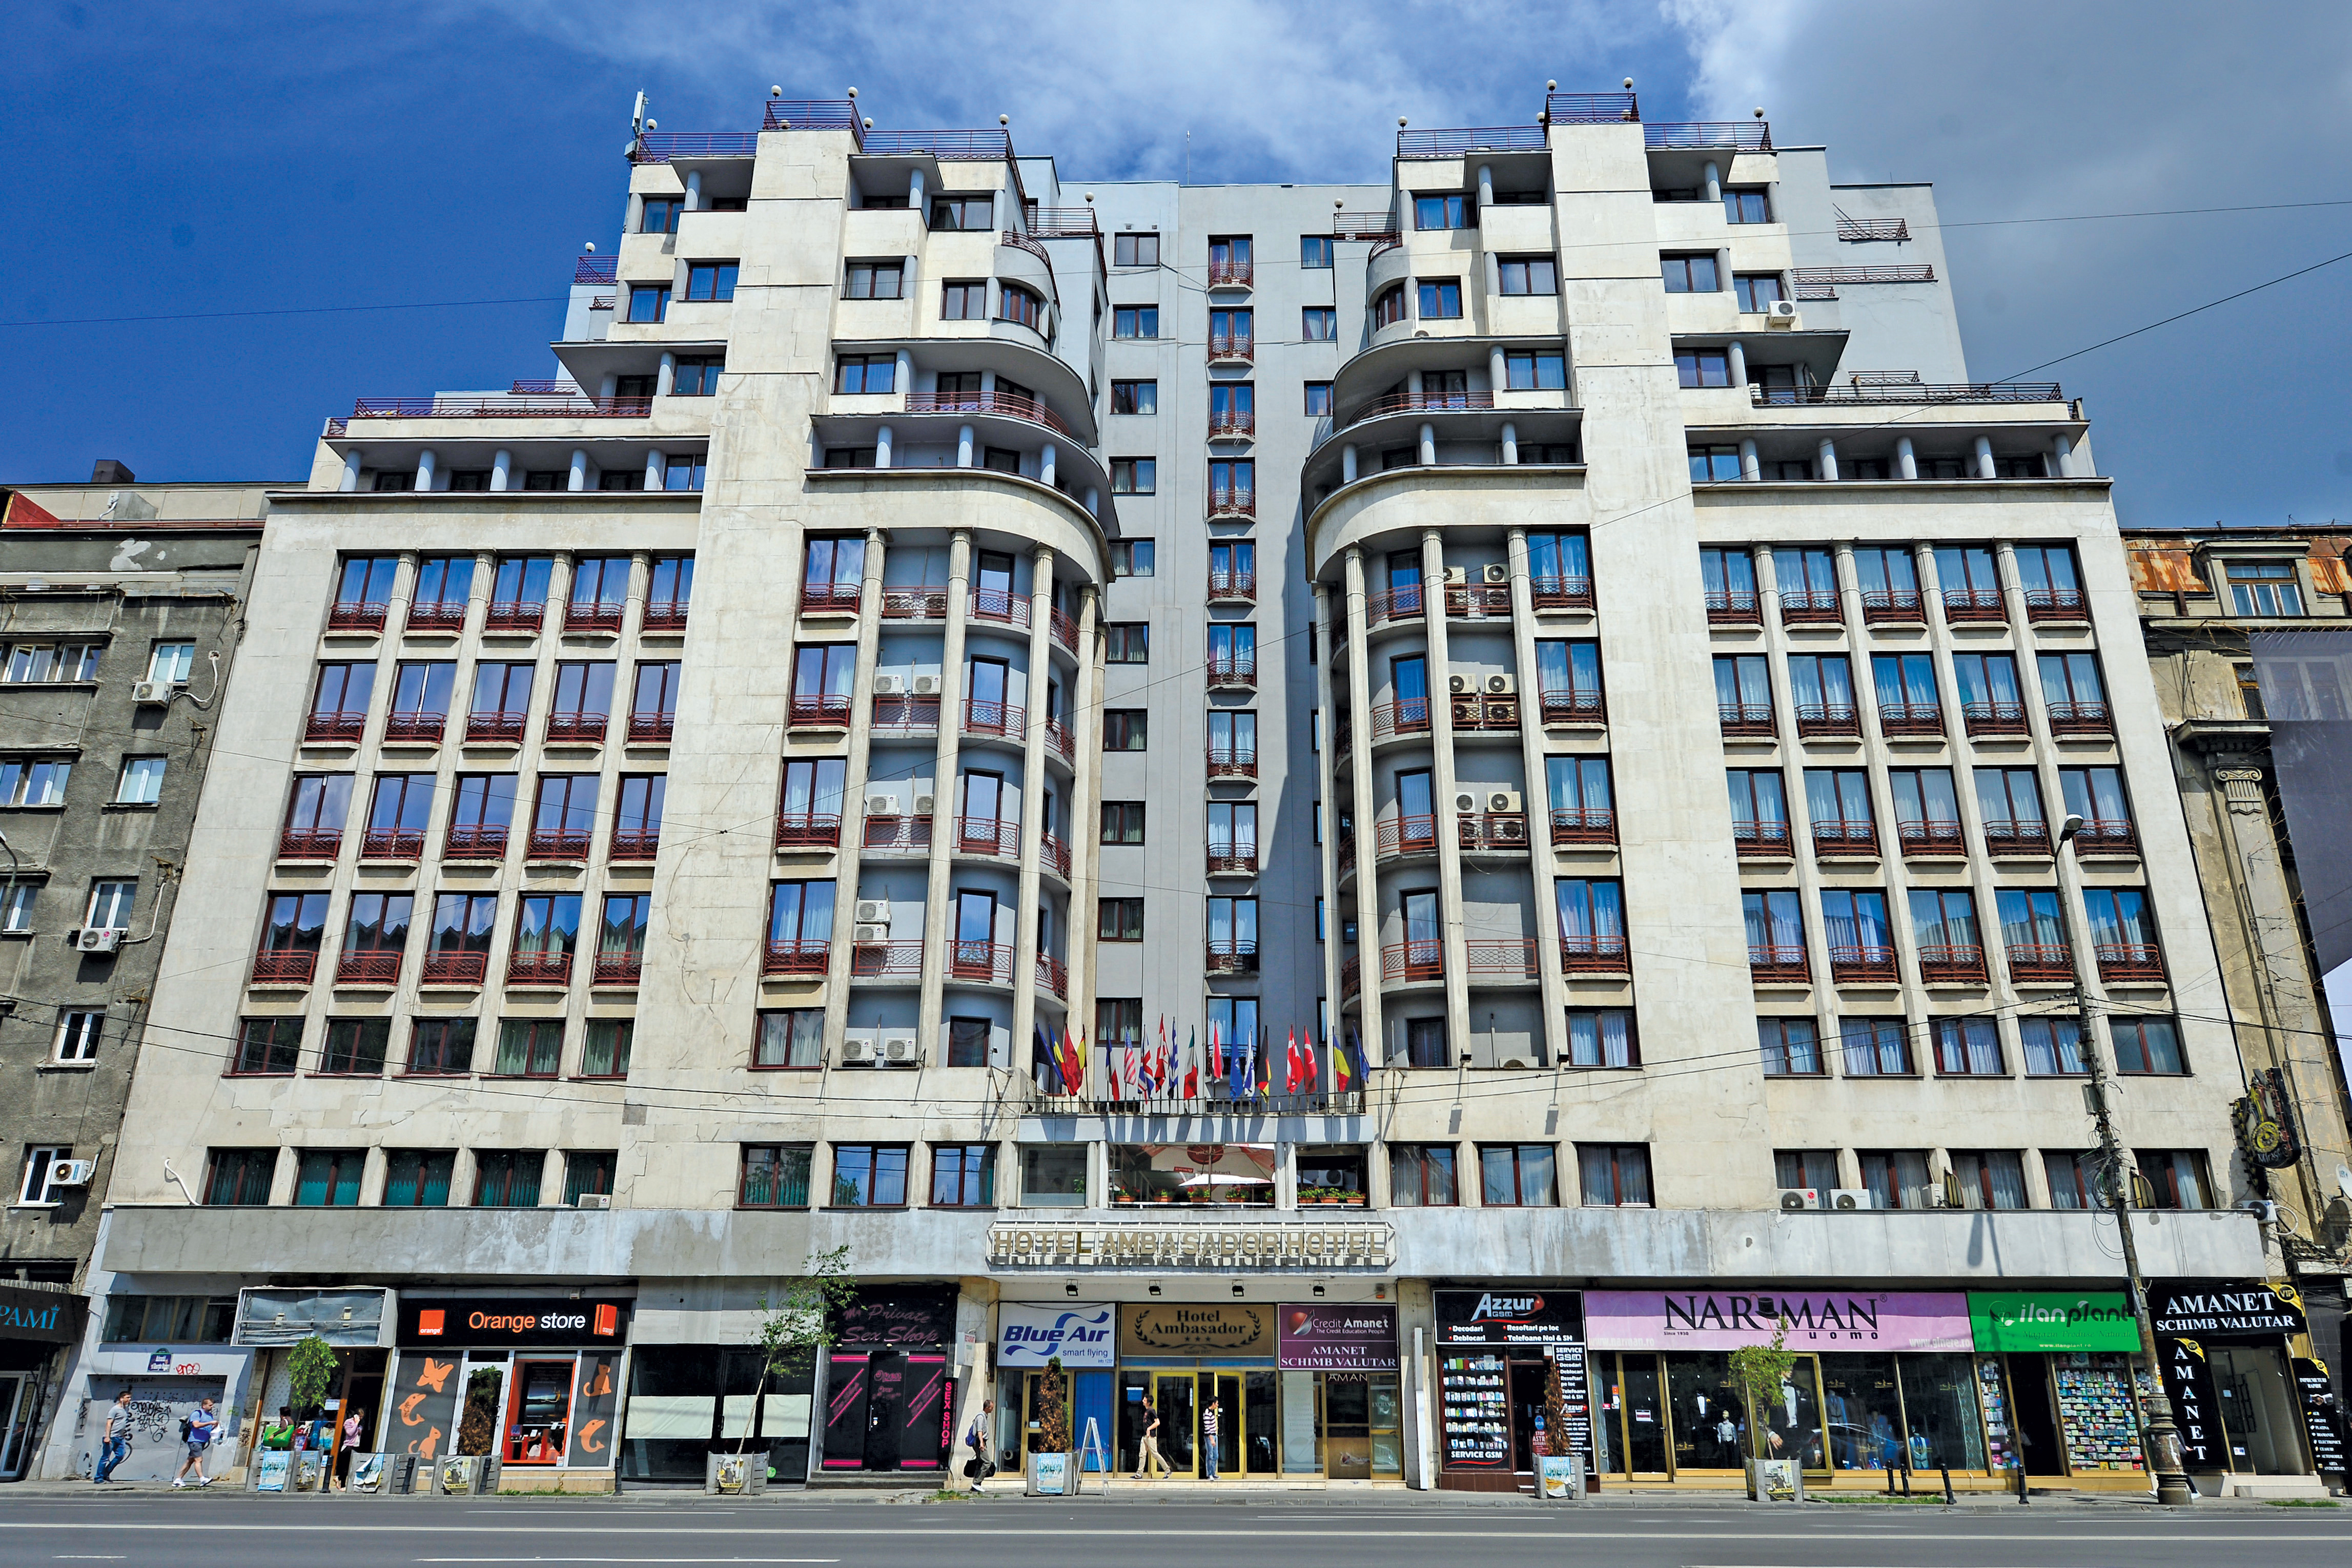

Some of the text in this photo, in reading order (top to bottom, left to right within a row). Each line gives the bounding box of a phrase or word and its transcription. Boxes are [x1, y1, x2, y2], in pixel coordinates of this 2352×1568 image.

[994, 1231, 1385, 1255] HOTEL AMBASADOR HOTEL
[2280, 1289, 2294, 1297] VIP
[2165, 1291, 2276, 1315] AMANET
[868, 1304, 930, 1323] Private
[1177, 1310, 1220, 1322] Hotel
[2019, 1303, 2129, 1328] ilanplant
[468, 1311, 586, 1333] Orange store
[1150, 1322, 1246, 1334] Ambasador
[1312, 1317, 1388, 1328] Credit Amanet
[2156, 1315, 2296, 1331] SCHIMB VALUTAR
[841, 1325, 939, 1347] Sex Shop
[1003, 1326, 1110, 1342] Blue Air
[1809, 1331, 1879, 1339] uomo
[2023, 1331, 2058, 1340] Magazin
[1588, 1337, 1655, 1347] www.narman.ro
[1909, 1337, 1971, 1348] www.ginere.ro
[1087, 1349, 1108, 1358] flying
[1311, 1346, 1367, 1355] AMANET
[1281, 1357, 1397, 1367] SCHIMB VALUTAR
[2174, 1346, 2207, 1460] AMANET
[941, 1411, 951, 1448] SHOP
